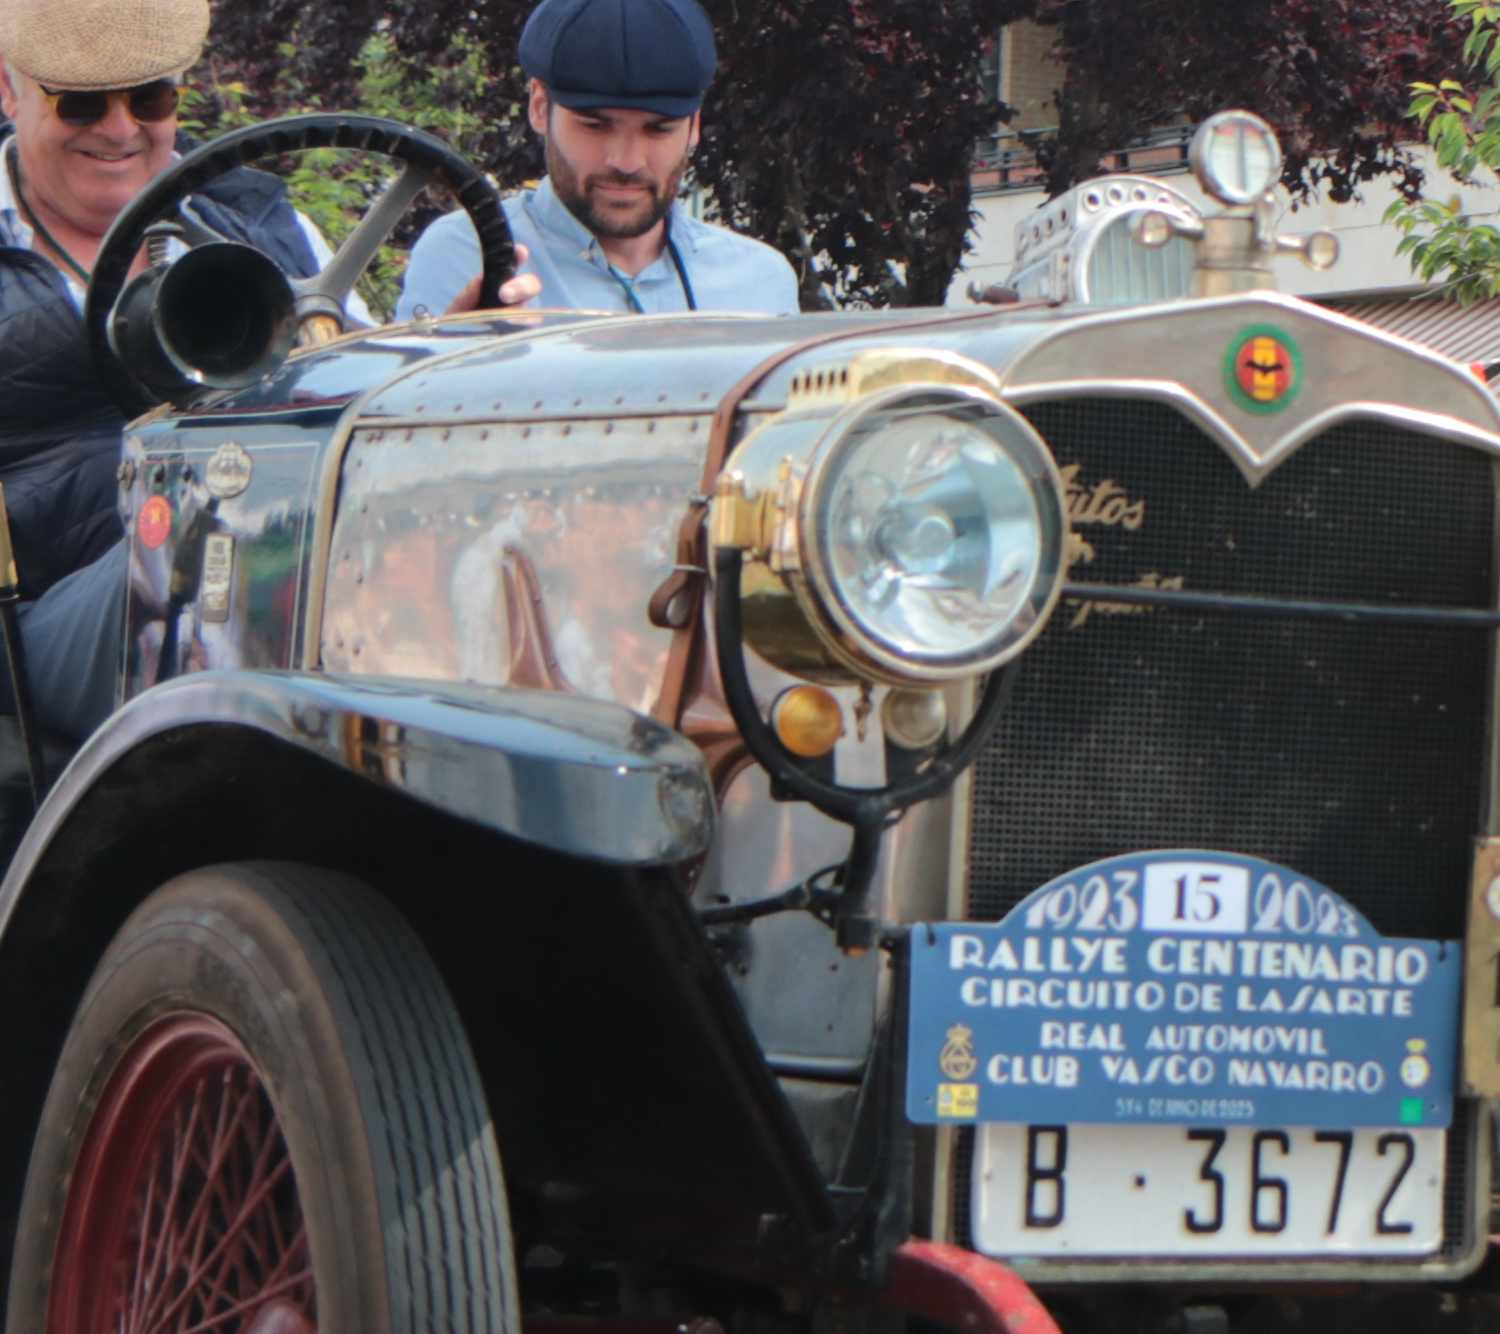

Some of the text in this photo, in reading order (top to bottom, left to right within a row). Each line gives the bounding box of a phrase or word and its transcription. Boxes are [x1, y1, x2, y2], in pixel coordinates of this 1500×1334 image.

[1060, 463, 1146, 530] utos
[1025, 869, 1361, 938] 1923 15 2023
[949, 934, 1430, 986] RALLYE CENTENARIO
[960, 975, 1414, 1017] CIRCUITO DE LASARTE
[1039, 1021, 1328, 1056] REAL AUTOMOVIL
[986, 1053, 1385, 1094] CLUB VASCO NAVARRO
[1024, 1124, 1416, 1234] B 3672
